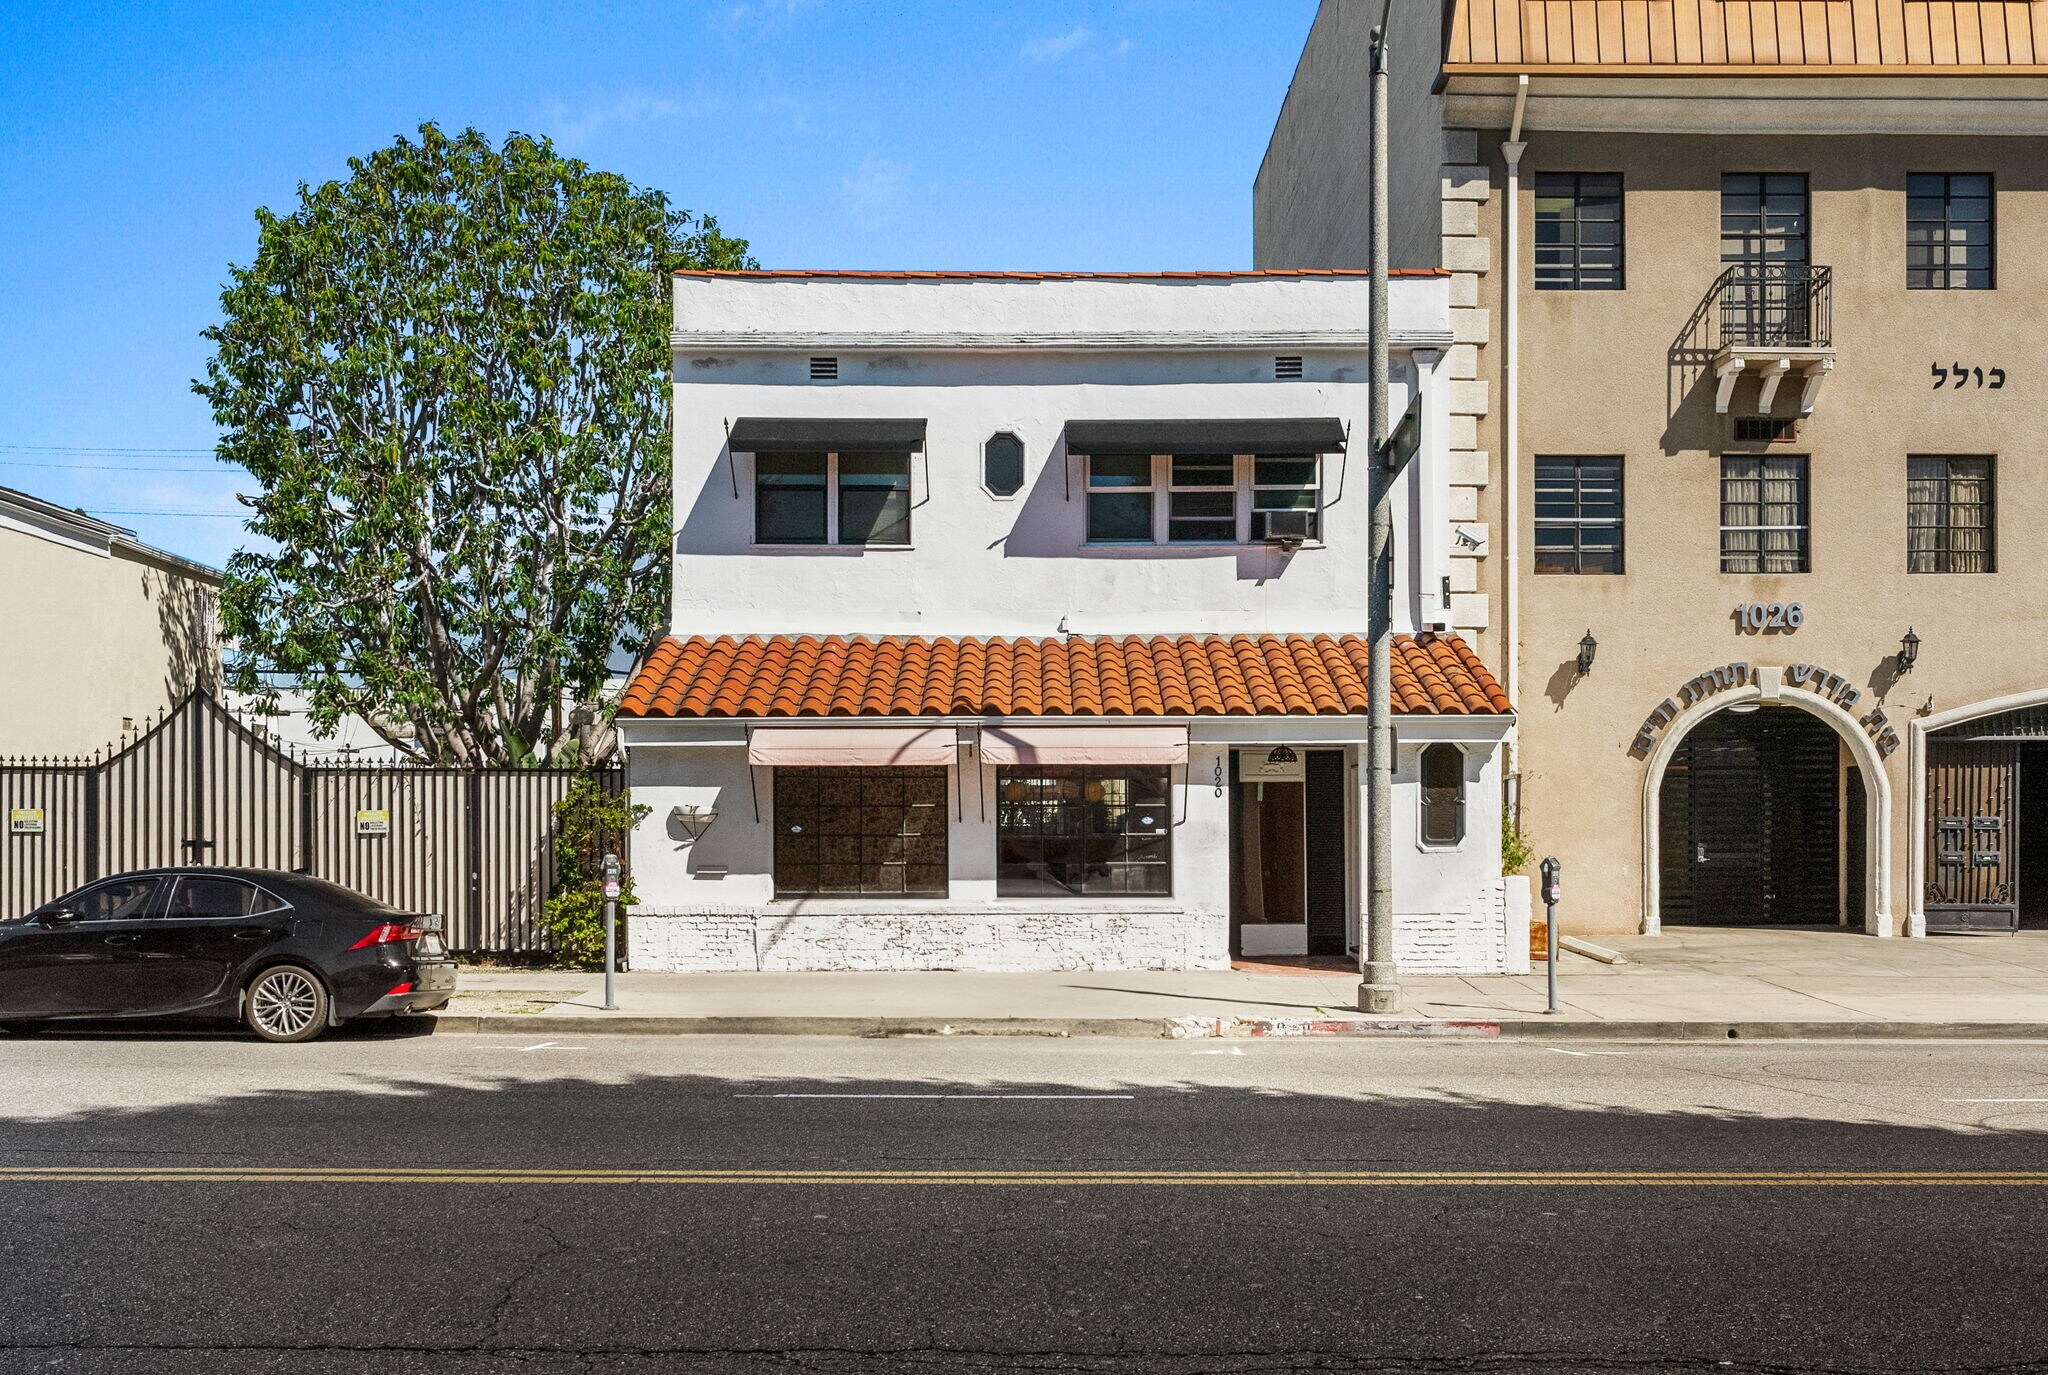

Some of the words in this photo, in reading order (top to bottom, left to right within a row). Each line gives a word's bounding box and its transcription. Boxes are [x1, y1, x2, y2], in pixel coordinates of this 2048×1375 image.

[1931, 361, 2006, 390] כולל
[1735, 601, 1805, 628] 1026
[1682, 661, 1750, 702] תורת
[1791, 662, 1862, 706] מדרש
[1632, 697, 1680, 753] חיים
[1861, 706, 1901, 756] בית
[1214, 755, 1223, 799] 1020
[13, 820, 24, 829] NO
[359, 821, 370, 831] NO
